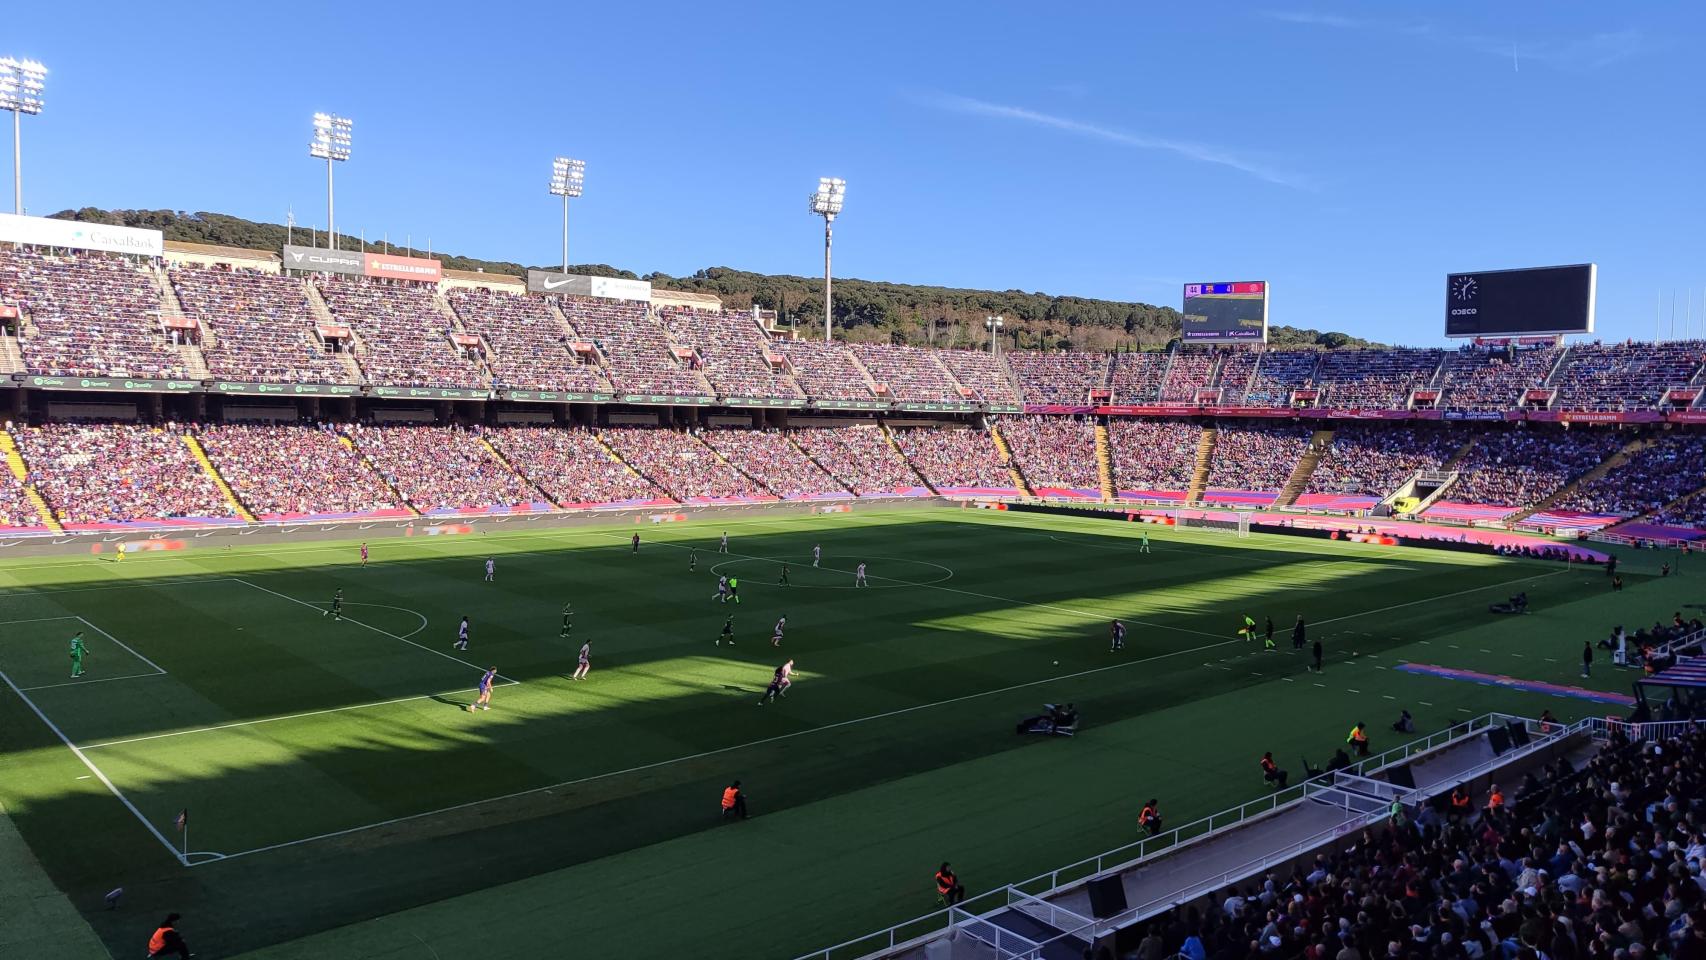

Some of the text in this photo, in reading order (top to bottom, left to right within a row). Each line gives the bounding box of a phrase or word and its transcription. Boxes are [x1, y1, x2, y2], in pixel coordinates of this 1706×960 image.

[90, 231, 154, 249] CaixaBank
[308, 255, 360, 266] CUPRA
[1451, 307, 1477, 315] ODECO
